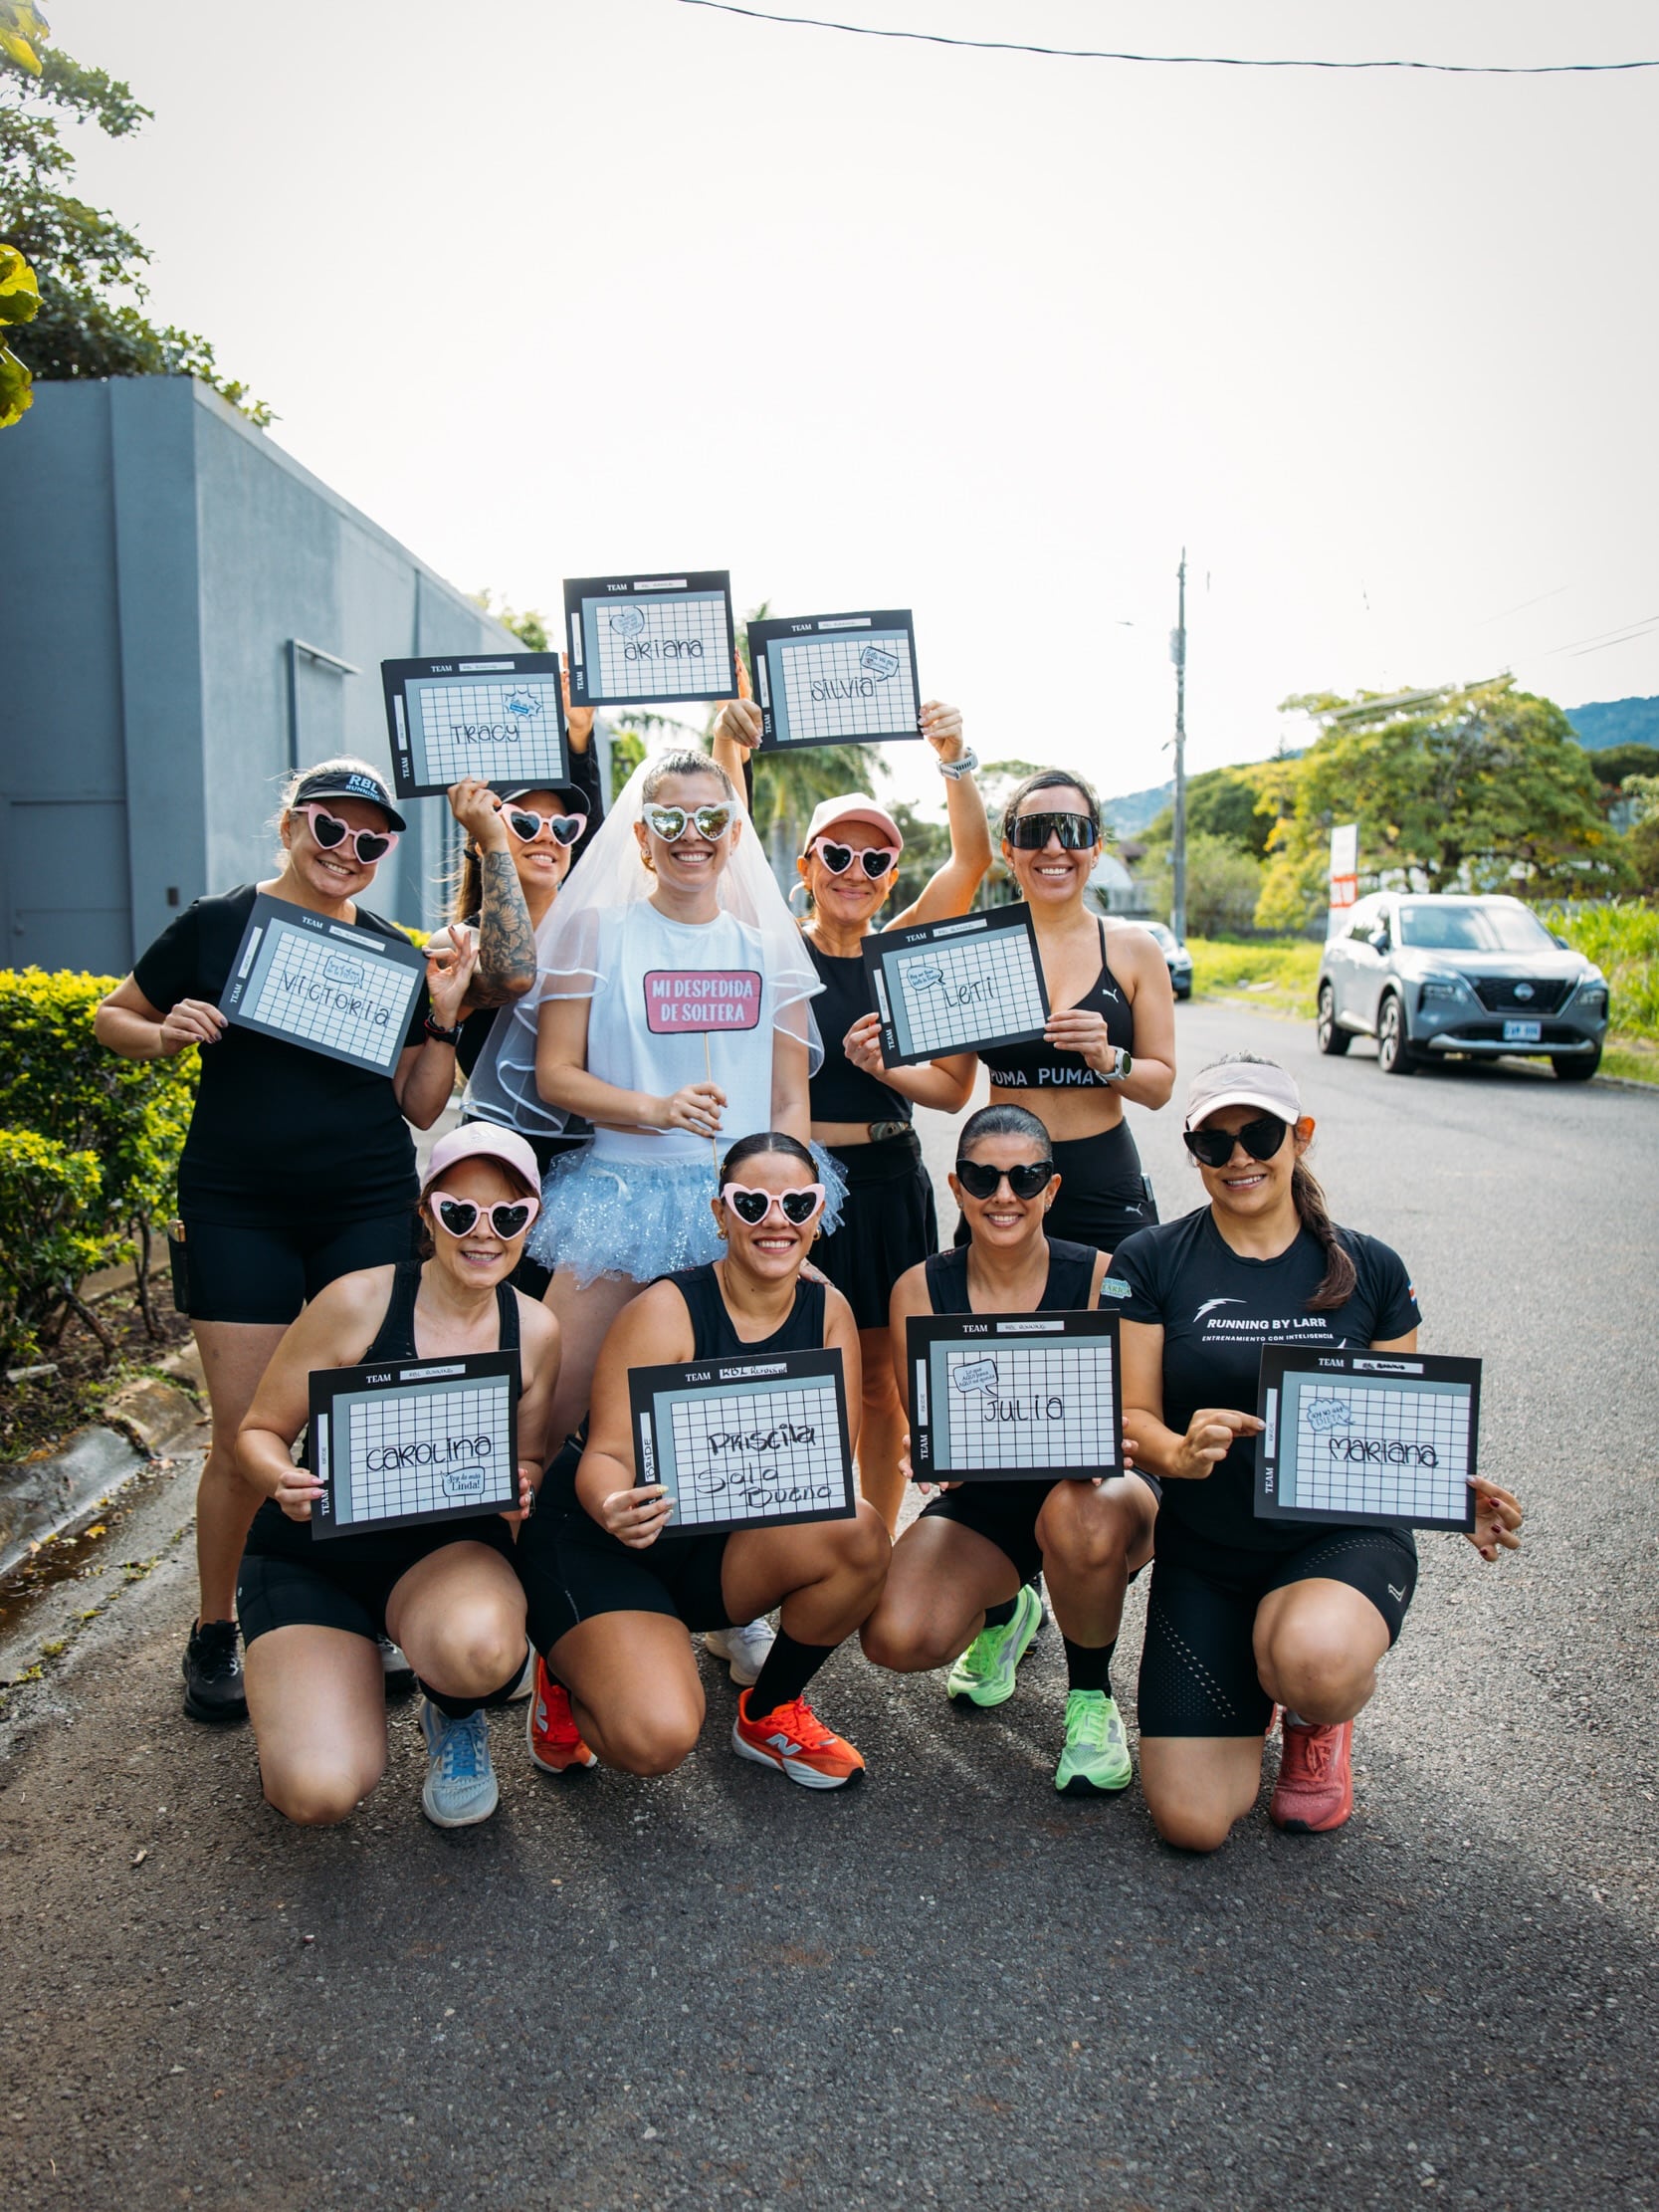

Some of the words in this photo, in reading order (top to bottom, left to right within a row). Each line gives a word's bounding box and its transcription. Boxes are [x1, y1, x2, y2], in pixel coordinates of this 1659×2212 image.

[401, 757, 410, 778] TEAM
[345, 784, 380, 800] RUNNING
[349, 774, 378, 793] RBL
[302, 916, 323, 929] TEAM
[906, 932, 927, 943] TEAM
[230, 984, 243, 1003] TEAM
[652, 980, 671, 998] MI
[674, 979, 753, 998] DESPEDIDA
[661, 1003, 679, 1022] DE
[682, 1002, 745, 1022] SOLTERA
[886, 1029, 895, 1050] TEAM
[990, 1068, 1027, 1085] PUMA
[1038, 1067, 1094, 1085] PUMA
[962, 1324, 988, 1333] TEAM
[1207, 1318, 1270, 1330] RUNNING
[1272, 1319, 1291, 1329] BY
[1294, 1318, 1328, 1328] LARR
[1319, 1357, 1345, 1368] TEAM
[366, 1373, 392, 1384] TEAM
[685, 1372, 711, 1382] TEAM
[452, 1479, 480, 1491] Linda!
[697, 1461, 779, 1494] Solo
[1265, 1467, 1274, 1494] TEAM
[738, 1485, 832, 1508] Bueno
[765, 1733, 802, 1756] N
